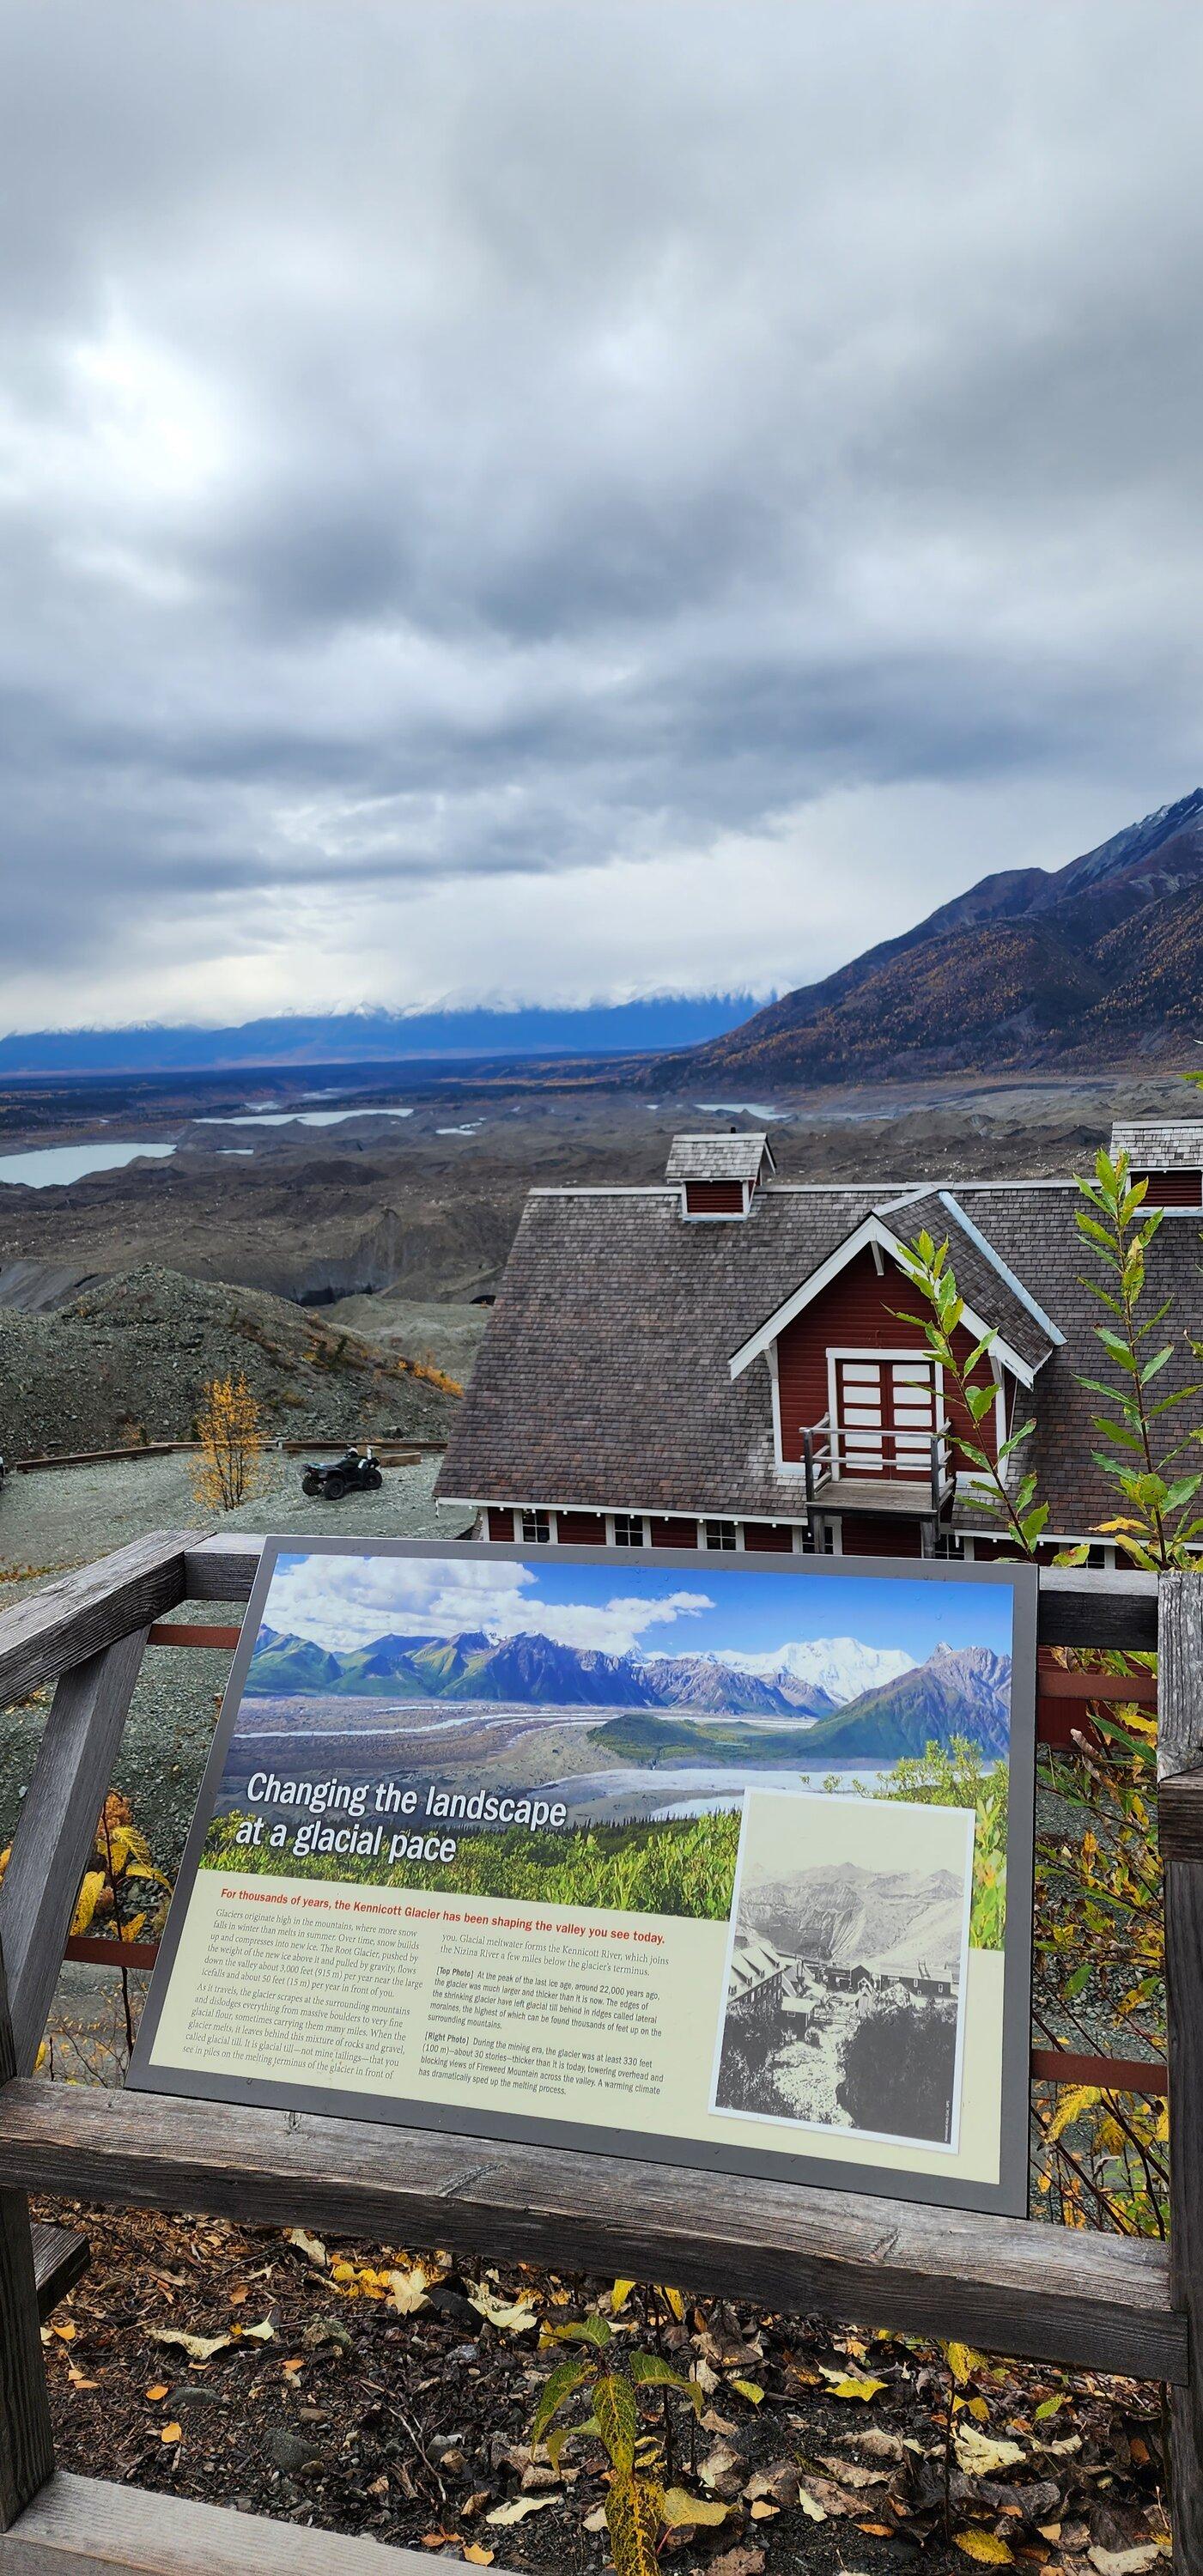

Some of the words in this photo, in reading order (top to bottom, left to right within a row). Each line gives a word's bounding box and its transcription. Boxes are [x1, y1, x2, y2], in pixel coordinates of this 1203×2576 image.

[247, 1772, 370, 1817] Changing
[374, 1783, 417, 1814] the
[425, 1785, 567, 1832] landscape
[235, 1817, 265, 1845] at
[269, 1824, 288, 1847] a
[292, 1820, 384, 1856] glacial
[388, 1834, 457, 1862] pace
[216, 1909, 243, 1918] Glaciers
[245, 1913, 275, 1923] originate
[276, 1915, 291, 1926] high
[302, 1917, 313, 1926] the
[314, 1921, 354, 1931] mountains,
[355, 1923, 376, 1933] where
[221, 1888, 237, 1899] For
[239, 1891, 288, 1904] thousands
[291, 1896, 301, 1905] of
[301, 1899, 331, 1910] years,
[335, 1900, 350, 1911] the
[354, 1901, 402, 1916] Kennicott
[404, 1907, 440, 1919] Glacier
[443, 1911, 461, 1922] has
[464, 1912, 489, 1924] been
[491, 1917, 532, 1931] shaping
[536, 1921, 552, 1931] the
[556, 1923, 586, 1937] valley
[588, 1928, 608, 1938] you
[611, 1930, 629, 1940] see
[634, 1931, 665, 1946] today.
[210, 1934, 220, 1942] up
[235, 1937, 273, 1946] compresses
[307, 1942, 318, 1951] ice.
[320, 1944, 333, 1953] The
[335, 1946, 352, 1954] Root
[354, 1947, 380, 1959] Glacier,
[381, 1952, 408, 1961] pushed
[410, 1953, 418, 1965] by
[214, 1920, 228, 1929] falls
[238, 1923, 259, 1933] winter
[261, 1925, 276, 1934] than
[277, 1928, 296, 1936] melts
[307, 1932, 336, 1941] summer.
[338, 1934, 356, 1942] Over
[358, 1936, 375, 1946] time,
[398, 1940, 419, 1950] builds
[459, 1935, 485, 1945] Glacial
[487, 1938, 523, 1948] meltwater
[525, 1941, 546, 1951] forms
[549, 1944, 560, 1953] the
[562, 1945, 598, 1957] Kennicott
[601, 1950, 623, 1960] River,
[625, 1953, 647, 1963] which
[649, 1955, 669, 1965] joins
[204, 1955, 223, 1965] down
[225, 1958, 236, 1966] the
[238, 1959, 258, 1971] valley
[258, 1961, 279, 1971] about
[280, 1965, 299, 1973] 3,000
[301, 1965, 313, 1975] feet
[314, 1968, 331, 1978] (915
[332, 1971, 343, 1980] m)
[343, 1973, 356, 1982] per
[392, 1977, 404, 1985] the
[405, 1978, 422, 1990] large
[208, 1944, 219, 1953] the
[221, 1947, 242, 1956] weight
[253, 1948, 264, 1957] the
[281, 1952, 291, 1960] ice
[292, 1953, 313, 1963] above
[335, 1959, 359, 1968] pulled
[360, 1960, 368, 1971] by
[369, 1964, 395, 1975] gravity,
[398, 1965, 416, 1975] flows
[436, 1966, 450, 1976] [Top
[452, 1968, 474, 1979] Photo]
[477, 1971, 484, 1979] At
[535, 1978, 547, 1986] last
[549, 1979, 558, 1988] ice
[560, 1982, 574, 1990] age,
[599, 1985, 624, 1996] 22,000
[626, 1990, 644, 1998] years
[646, 1992, 659, 2001] ago,
[195, 1996, 209, 2004] and
[210, 1996, 241, 2009] dislodges
[243, 2002, 280, 2014] everything
[282, 2005, 298, 2014] from
[301, 2010, 328, 2019] massive
[330, 2010, 361, 2022] boulders
[372, 2018, 388, 2027] very
[389, 2018, 403, 2027] fine
[207, 1984, 213, 1992] it
[215, 1986, 238, 1996] travels,
[240, 1988, 252, 1996] the
[252, 1989, 276, 2000] glacier
[277, 1994, 303, 2003] scrapes
[313, 1996, 325, 2005] the
[325, 2000, 370, 2013] surrounding
[372, 2006, 410, 2015] mountains
[191, 2007, 215, 2018] glacial
[216, 2009, 233, 2020] flour,
[235, 2014, 272, 2024] sometimes
[274, 2020, 304, 2031] carrying
[305, 2020, 324, 2031] them
[325, 2026, 346, 2036] many
[347, 2026, 368, 2037] miles.
[371, 2029, 392, 2039] When
[394, 2032, 406, 2041] the
[425, 2032, 446, 2042] [Right
[447, 2034, 469, 2046] Photo]
[473, 2038, 495, 2050] During
[507, 2043, 531, 2054] mining
[546, 2047, 556, 2056] the
[557, 2049, 580, 2058] glacier
[605, 2054, 622, 2064] least
[623, 2057, 637, 2066] 330
[640, 2059, 652, 2068] feet
[418, 2068, 430, 2076] has
[432, 2069, 471, 2083] dramatically
[501, 2079, 511, 2087] the
[513, 2081, 538, 2093] melting
[538, 2086, 566, 2094] process.
